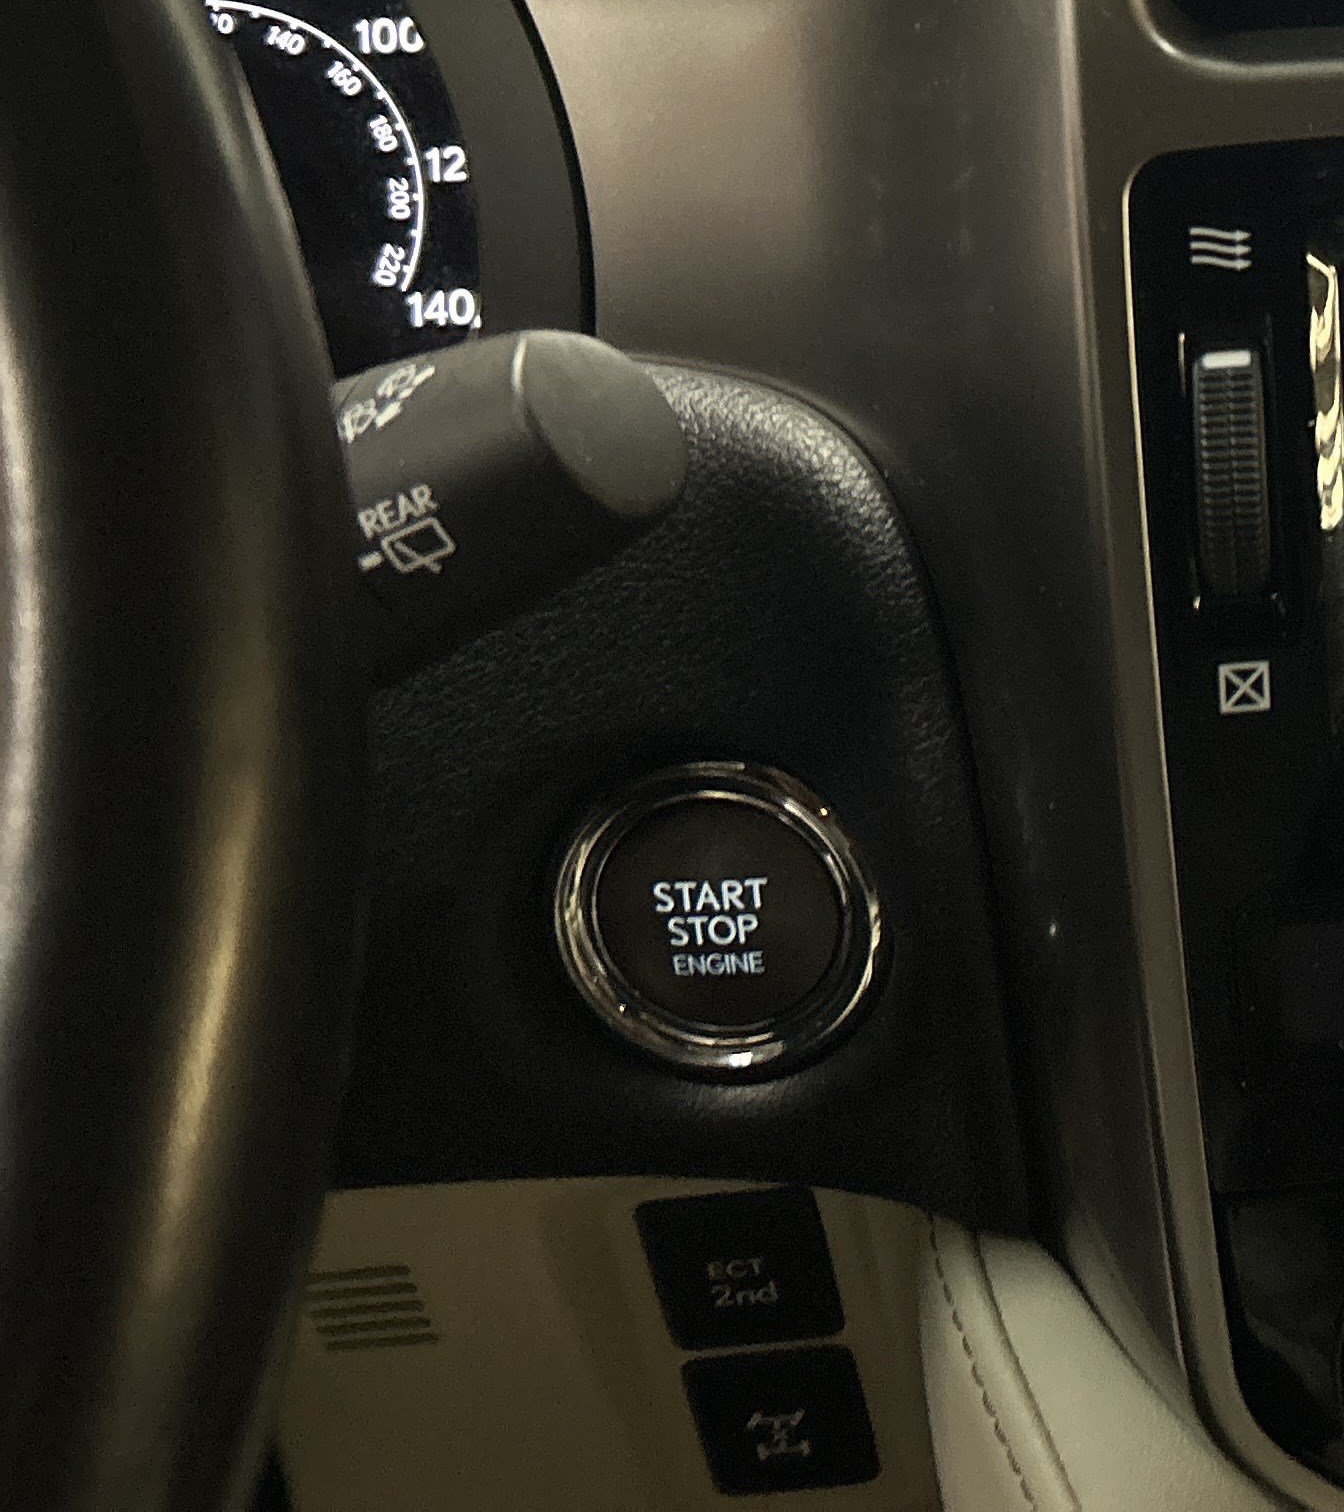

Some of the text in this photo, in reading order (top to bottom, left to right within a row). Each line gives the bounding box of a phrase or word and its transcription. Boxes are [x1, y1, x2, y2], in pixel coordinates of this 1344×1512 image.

[267, 25, 306, 56] 140
[354, 16, 424, 55] 100
[326, 59, 363, 98] 160
[368, 113, 398, 154] 180
[388, 178, 412, 222] 200
[372, 241, 406, 288] 220
[406, 286, 474, 328] 140
[357, 484, 438, 539] REAR
[653, 877, 768, 912] START
[668, 916, 759, 947] STOP
[671, 952, 765, 977] ENGINE
